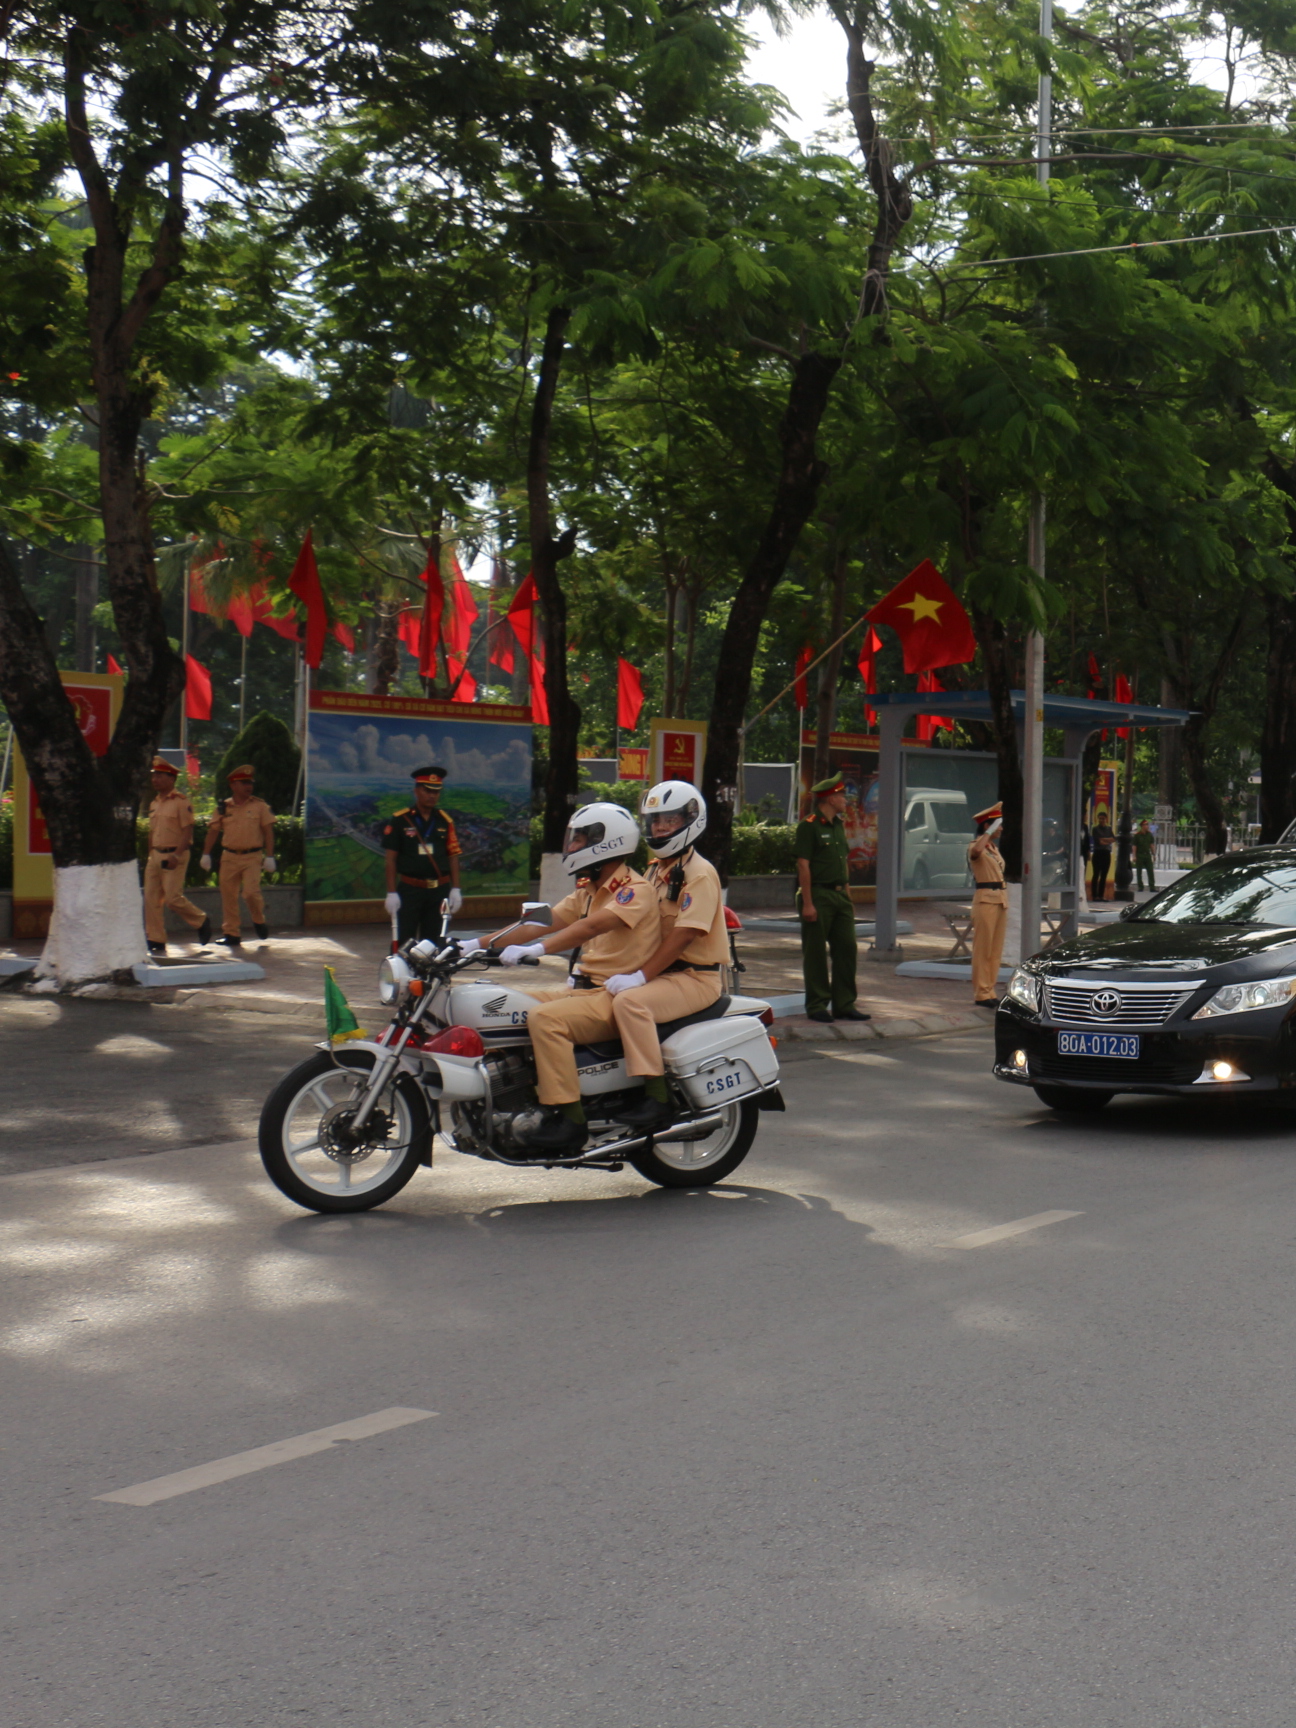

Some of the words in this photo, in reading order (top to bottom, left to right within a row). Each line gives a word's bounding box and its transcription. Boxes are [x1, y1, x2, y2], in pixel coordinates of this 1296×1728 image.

[592, 836, 625, 855] CSGT
[1060, 1034, 1137, 1056] 80A-012.03
[577, 1061, 619, 1077] POLICE
[706, 1072, 741, 1094] CSGT
